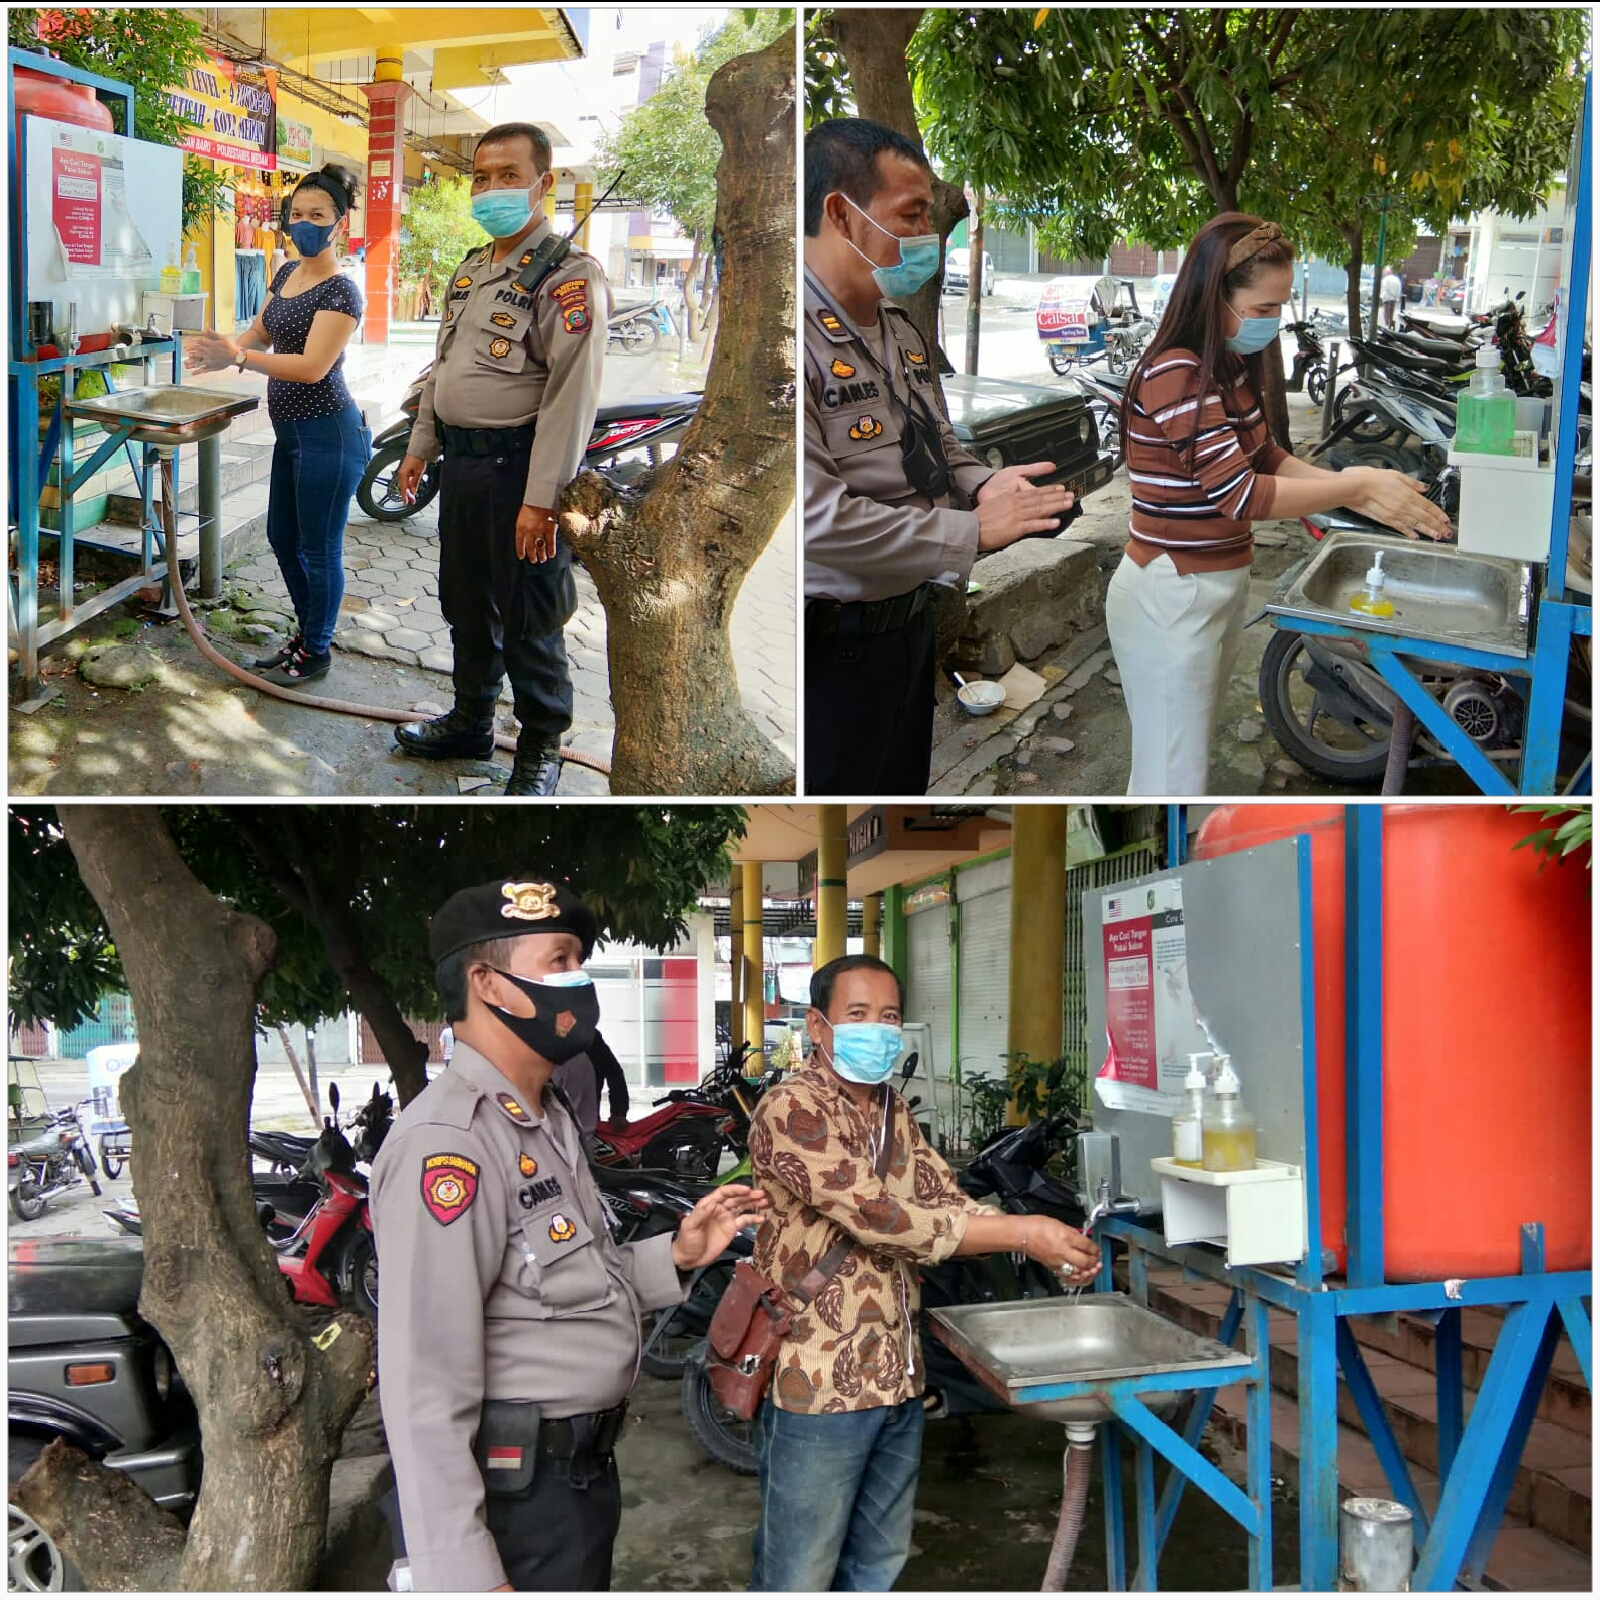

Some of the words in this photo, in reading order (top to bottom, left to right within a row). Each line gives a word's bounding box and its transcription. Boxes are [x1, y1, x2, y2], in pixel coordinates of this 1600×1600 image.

[191, 68, 220, 99] LEVEL
[229, 81, 235, 104] 4
[213, 109, 237, 138] KOTA
[238, 116, 266, 146] MEDAN
[195, 138, 212, 153] BARU
[494, 289, 533, 311] POLRI
[1038, 311, 1082, 325] Caisar
